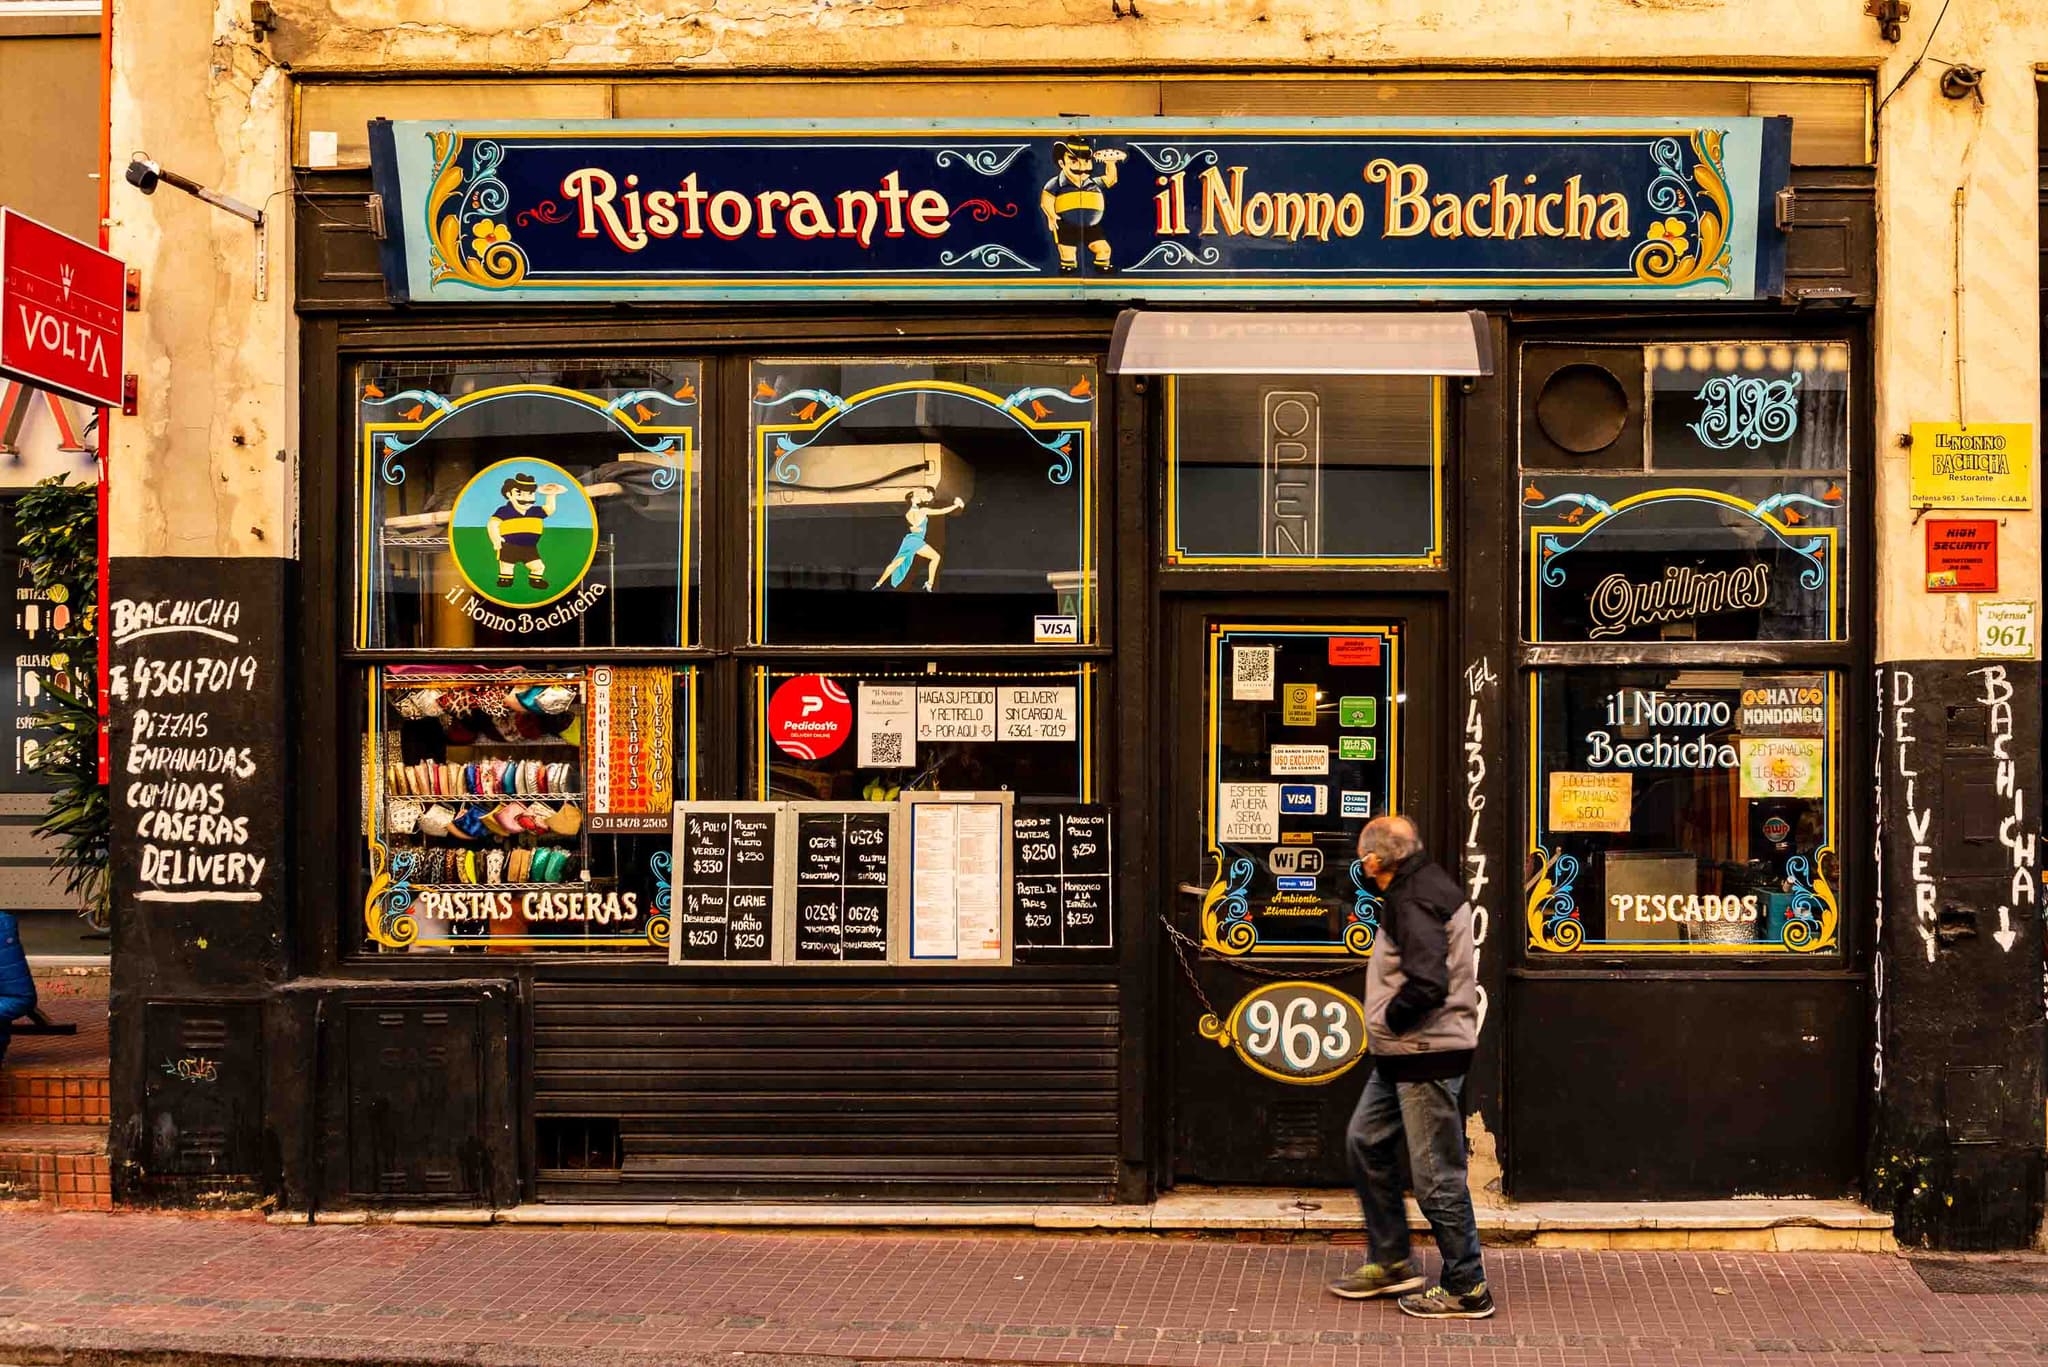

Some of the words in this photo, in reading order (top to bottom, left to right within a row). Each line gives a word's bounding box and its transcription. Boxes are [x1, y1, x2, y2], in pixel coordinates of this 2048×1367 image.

[560, 166, 952, 254] Ristorante
[1153, 169, 1187, 238] il
[1199, 165, 1365, 241] Nonno
[1364, 157, 1632, 242] Bachicha
[19, 303, 109, 378] VOLTA
[1950, 435, 2006, 450] NONNO
[1932, 453, 2010, 475] BACHICHA
[1272, 399, 1310, 555] OPEN
[1946, 528, 1976, 538] HIGH
[1933, 541, 1991, 550] SECURITY
[444, 584, 465, 605] il
[460, 595, 517, 633] Nonno
[517, 582, 608, 634] Bachicha
[1589, 562, 1770, 640] Quilmes
[110, 599, 240, 637] BACHICHA
[1987, 610, 2027, 622] Defensa
[1040, 623, 1072, 635] VISA
[1985, 625, 2027, 647] 961
[133, 655, 258, 699] 43617019
[919, 691, 945, 704] HAGA
[945, 691, 959, 704] SU
[960, 691, 994, 704] PEDIDO
[1013, 691, 1059, 704] DELIVERY
[1766, 687, 1799, 705] HAY
[930, 708, 937, 721] Y
[1021, 708, 1054, 721] CARGO
[1055, 708, 1068, 721] AL
[1605, 690, 1626, 726] il
[1632, 690, 1731, 727] Nonno
[1743, 706, 1823, 725] MONDONGO
[784, 720, 838, 731] PedidosYa
[935, 725, 955, 737] POR
[1007, 725, 1033, 737] 4361
[1040, 725, 1067, 737] 7019
[629, 685, 639, 791] TAPABOCAS
[653, 683, 664, 792] ACCESORIOS
[1585, 730, 1741, 769] Bachicha
[126, 743, 257, 779] EMPANADAS
[1275, 755, 1288, 765] USO
[1289, 755, 1325, 765] EXCLUSIVO
[1230, 785, 1267, 797] ESPERE
[1767, 780, 1796, 793] $150
[1966, 664, 2037, 907] BACHICHA
[1230, 798, 1268, 810] AFUERA
[1286, 793, 1312, 805] VISA
[1014, 818, 1038, 827] GUISO
[1236, 810, 1262, 822] SERA
[1892, 670, 1938, 963] DELIVERY
[137, 810, 249, 845] CASERAS
[703, 821, 727, 833] POLLO
[733, 818, 768, 831] POLENTA
[1067, 826, 1092, 837] POLLO
[1226, 823, 1272, 835] ATENDIDO
[701, 837, 714, 845] AL
[809, 835, 837, 849] $250
[850, 828, 884, 845] $250
[692, 847, 726, 856] VERDEO
[736, 851, 765, 864] $250
[1022, 843, 1056, 863] $250
[1071, 843, 1096, 859] $250
[693, 860, 723, 875] $330
[1016, 881, 1045, 895] PASTEL
[701, 893, 724, 906] POLLO
[733, 895, 767, 908] CARNE
[1271, 891, 1322, 904] Ambiente
[419, 891, 513, 921] PASTAS
[522, 890, 638, 925] CASERAS
[848, 906, 879, 922] $290
[1610, 894, 1759, 923] PESCADOS
[742, 912, 755, 921] AL
[1025, 912, 1051, 928] $250
[1066, 911, 1094, 928] $250
[731, 920, 762, 932] HORNO
[688, 929, 718, 946] $250
[734, 933, 764, 950] $250
[1246, 996, 1351, 1071] 963
